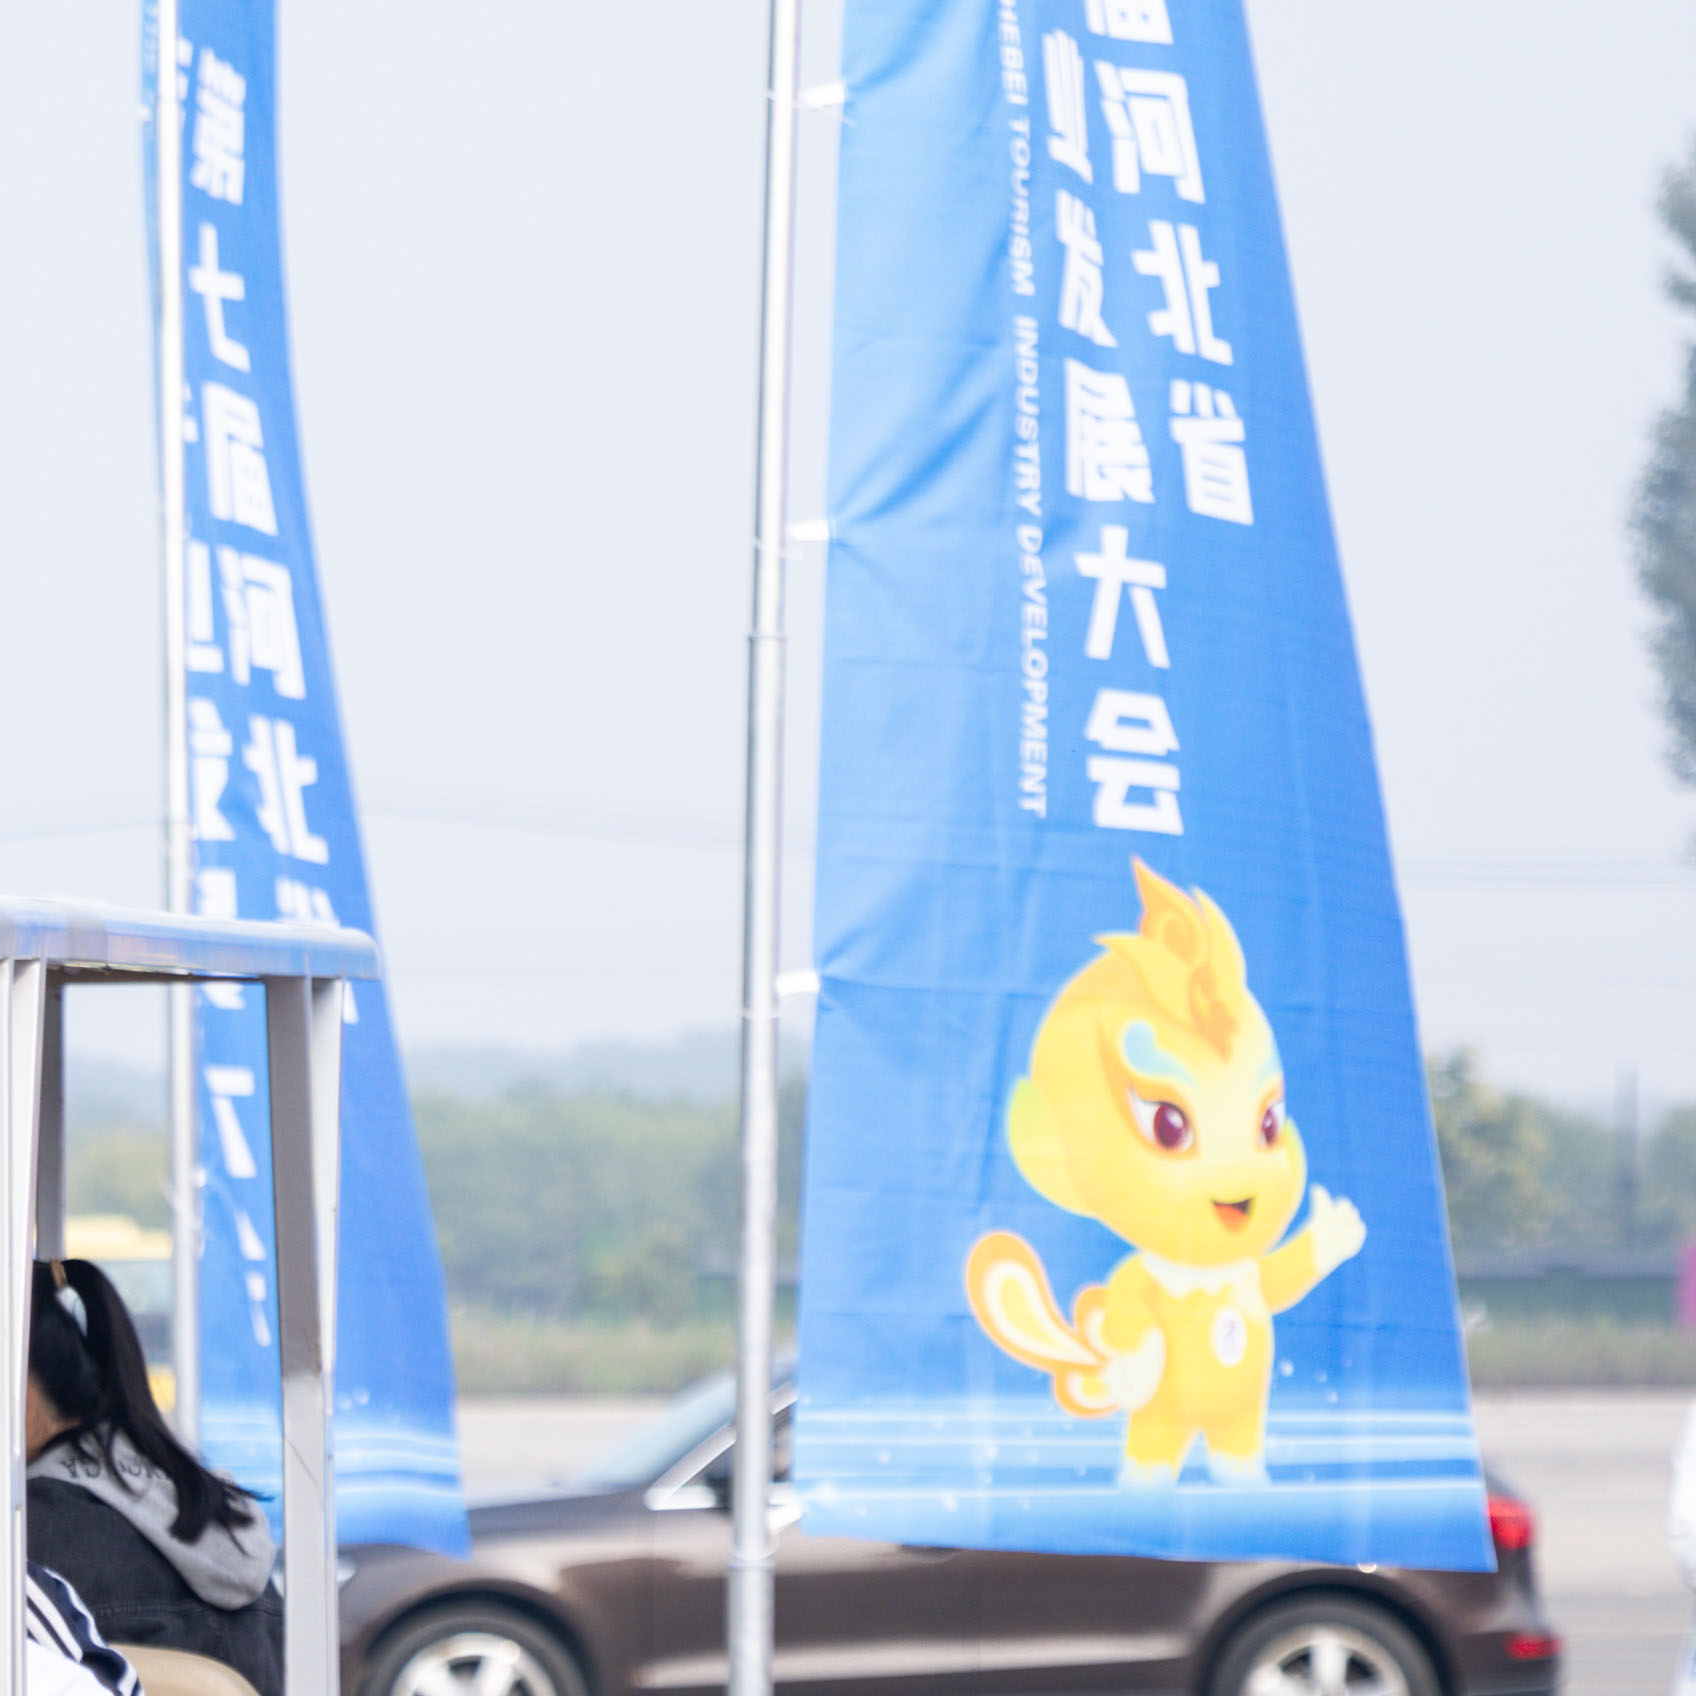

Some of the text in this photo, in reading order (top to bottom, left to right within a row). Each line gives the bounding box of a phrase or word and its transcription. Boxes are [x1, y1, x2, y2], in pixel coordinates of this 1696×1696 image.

[1008, 117, 1036, 296] TOURISM
[1012, 315, 1043, 517] INDUSTRY
[1015, 525, 1049, 819] DEVELOPMENT
